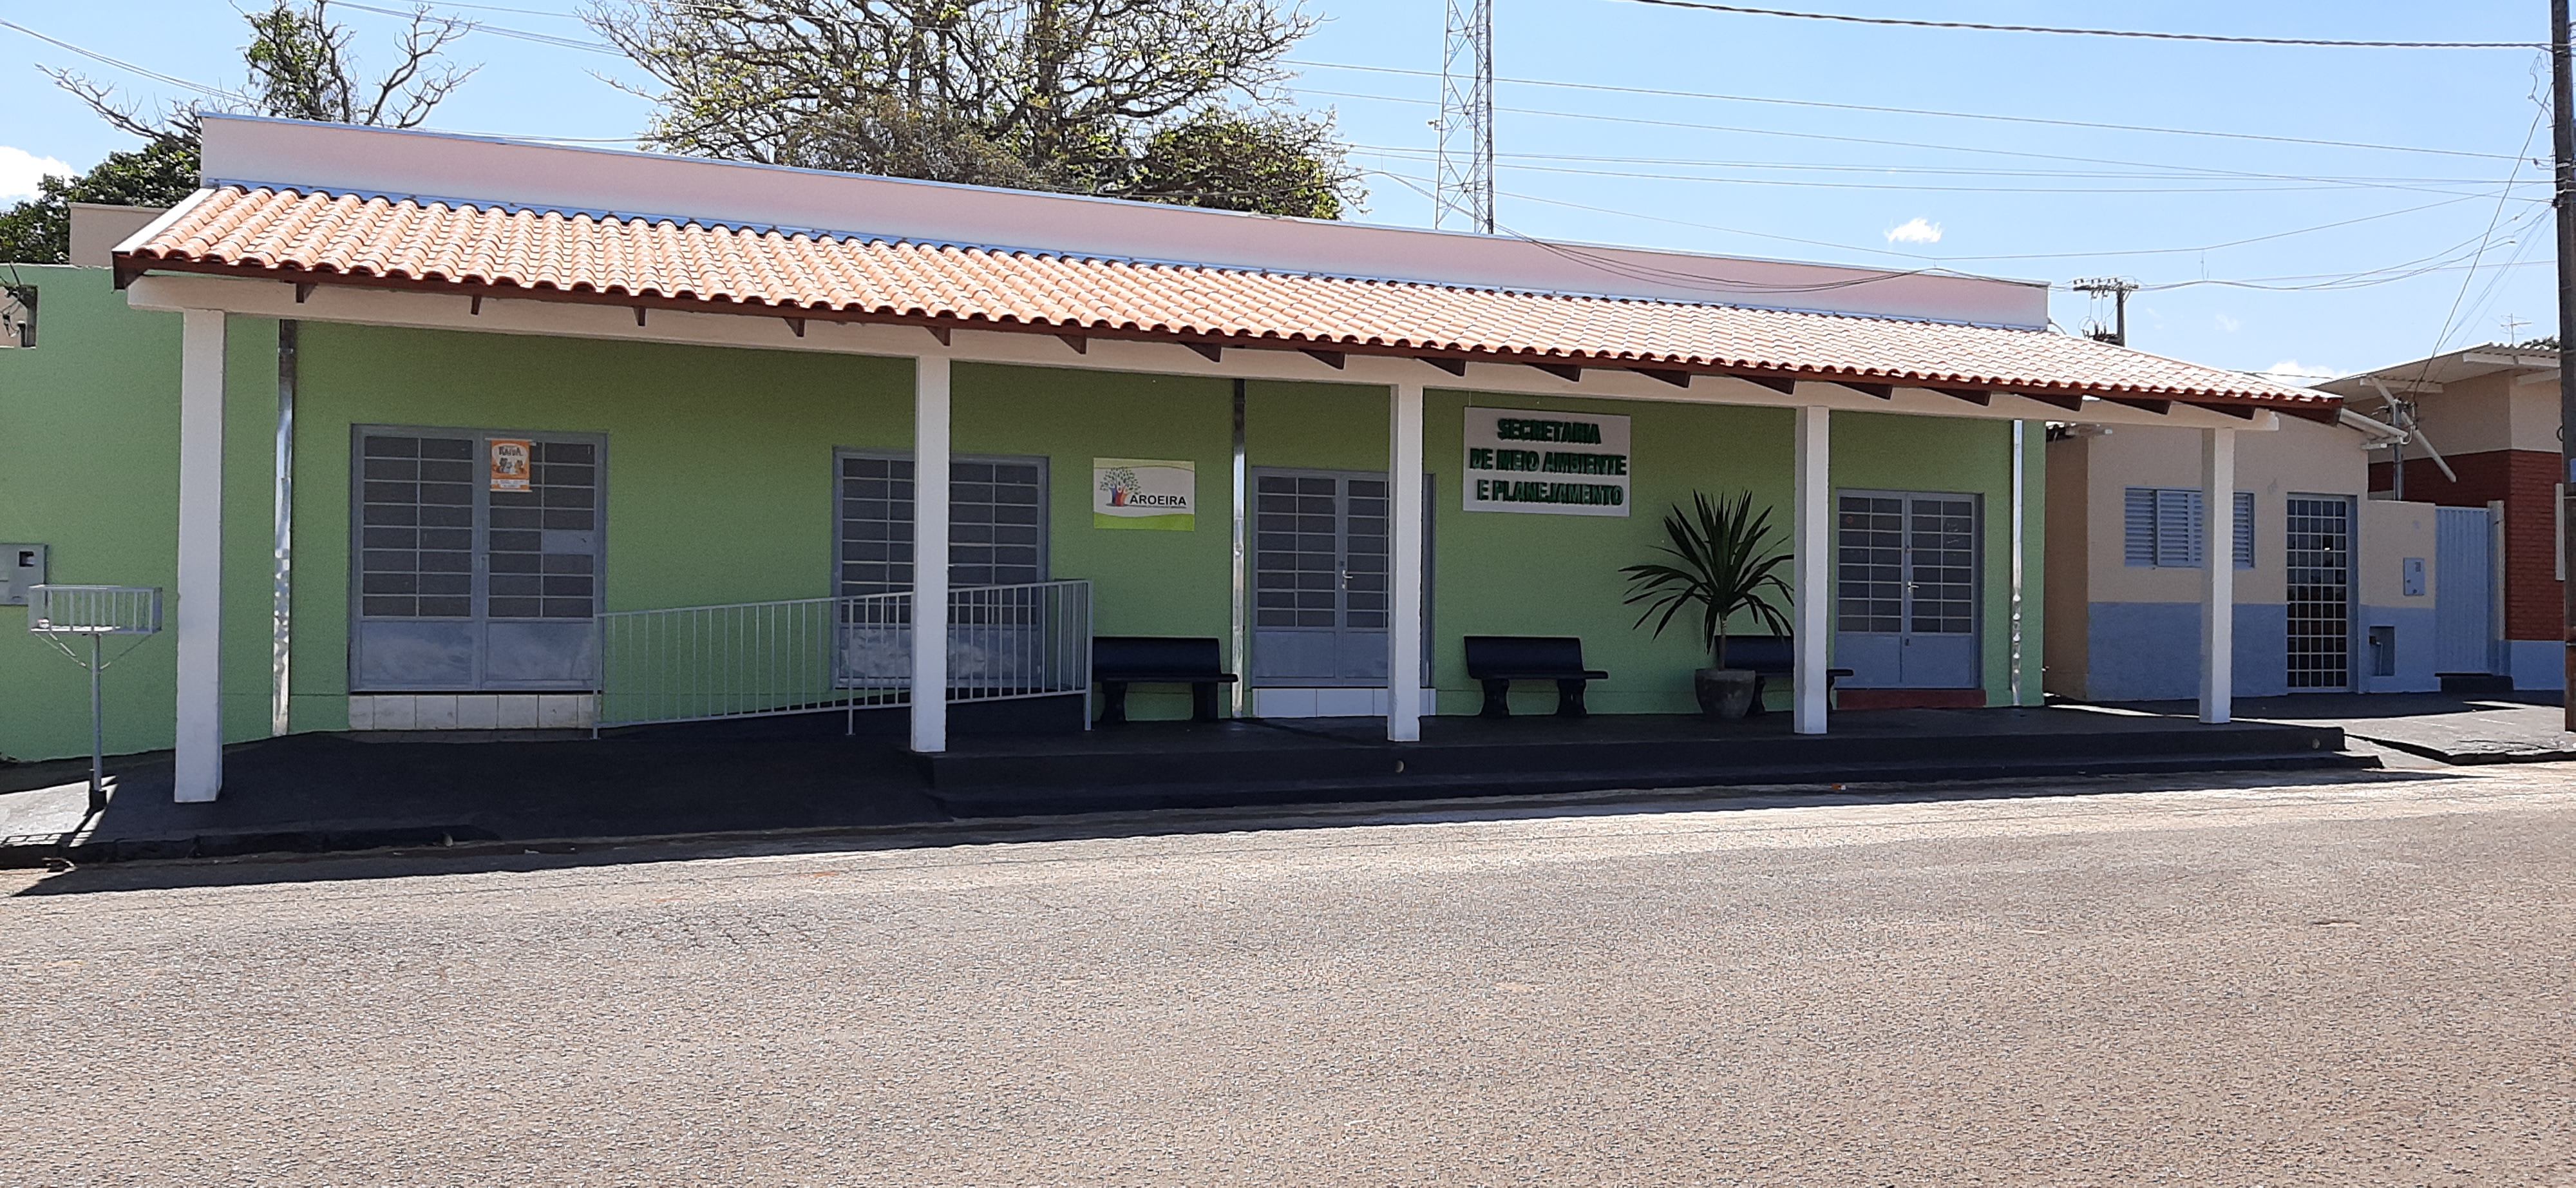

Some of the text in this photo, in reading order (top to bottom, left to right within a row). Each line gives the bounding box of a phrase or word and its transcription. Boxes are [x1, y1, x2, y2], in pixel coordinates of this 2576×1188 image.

[1497, 418, 1602, 444] SECRETARIA
[1469, 448, 1627, 475] DE MEIO AMBIENTE
[1130, 495, 1187, 505] AROEIRA
[1477, 479, 1624, 506] E PLANEJAMENTO
